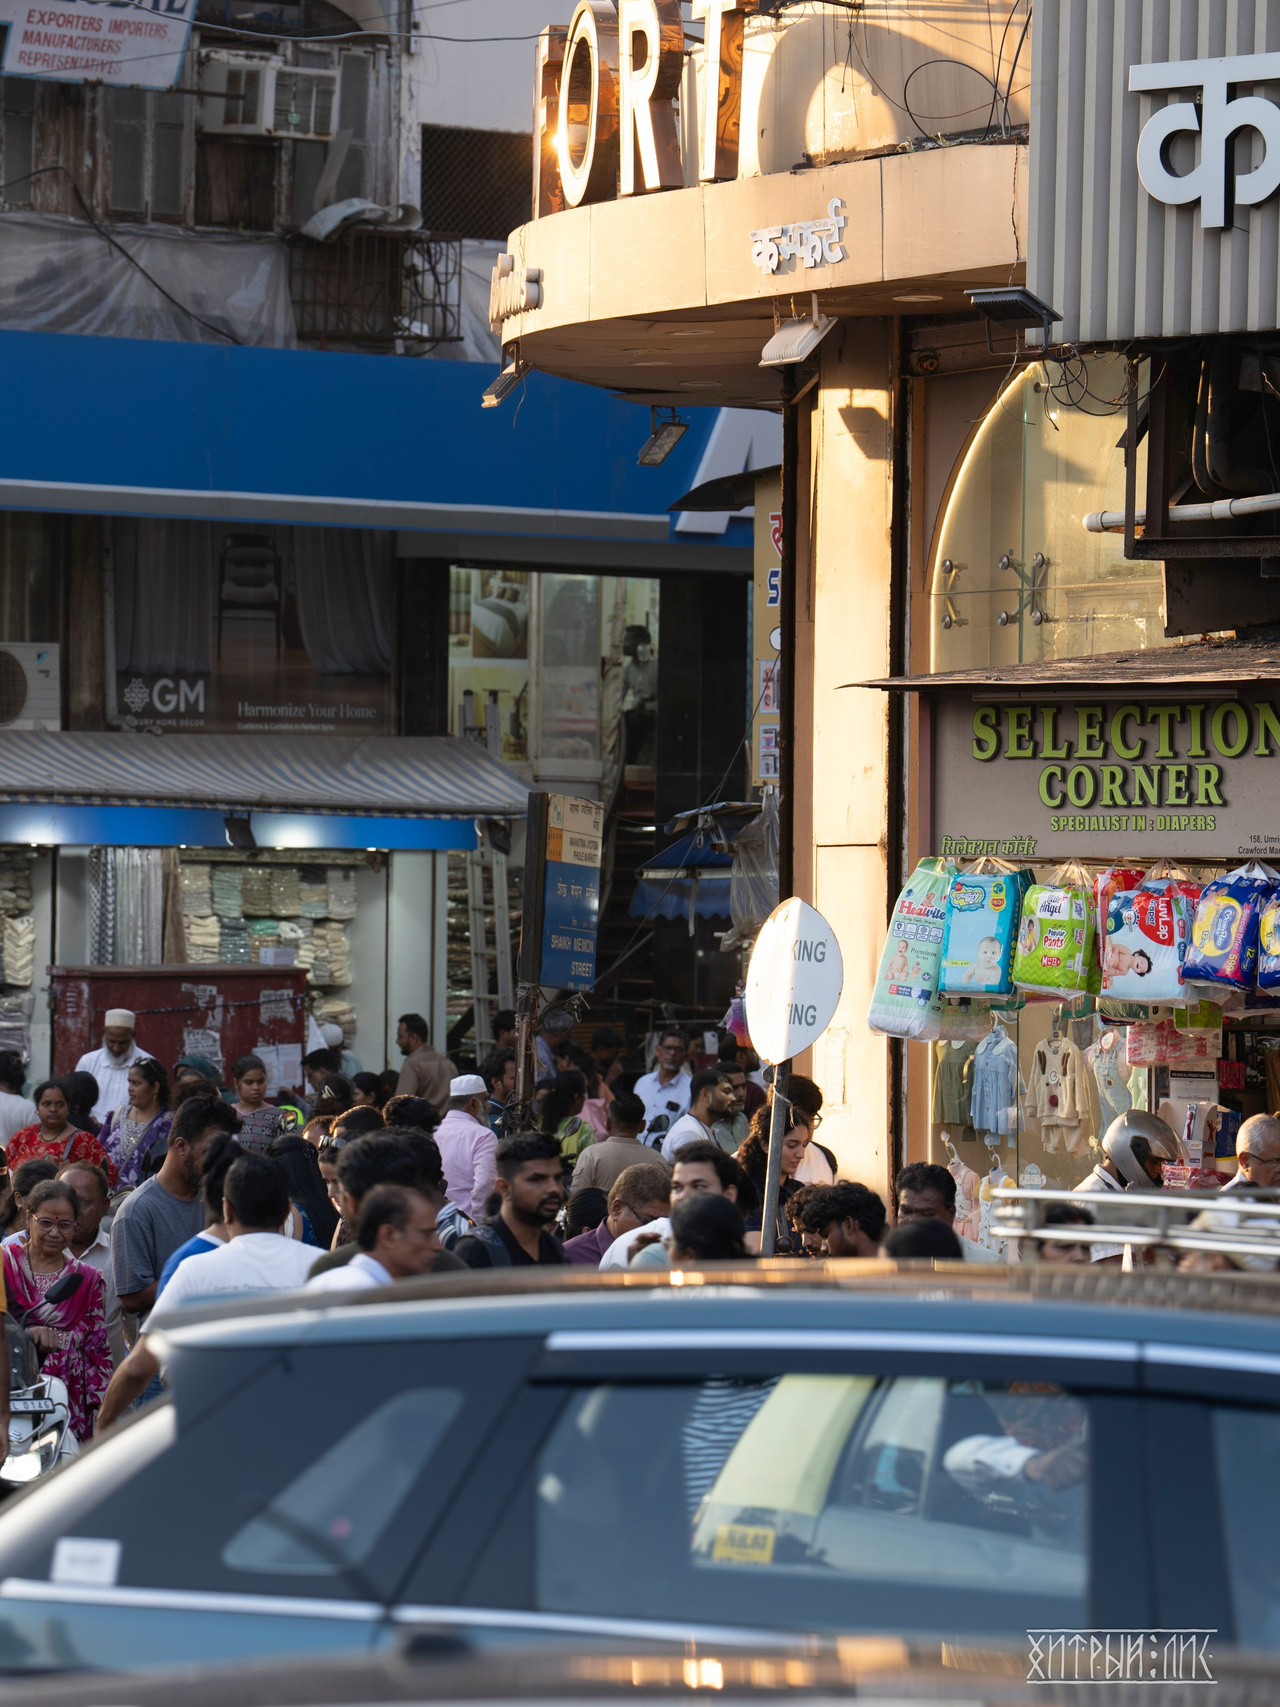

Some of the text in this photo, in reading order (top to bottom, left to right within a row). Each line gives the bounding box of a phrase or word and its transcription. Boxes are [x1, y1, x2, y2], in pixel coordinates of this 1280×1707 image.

[26, 9, 169, 39] EXPORTERS IMPORTERS
[21, 30, 123, 54] MANUFACTURERS
[17, 50, 123, 76] REPRESENTATIVES
[152, 678, 205, 713] GM
[238, 701, 376, 719] Harmonize Your Home
[156, 718, 177, 727] HOME
[1038, 764, 1226, 809] CORNER
[1050, 815, 1129, 832] SPECIALIST
[1131, 815, 1147, 831] IN
[1156, 815, 1216, 832] DIAPERS
[941, 834, 1038, 855] सिलेक्शन कॉर्नर
[1249, 835, 1280, 845] 158, Umri
[1238, 846, 1268, 855] Crawford
[898, 899, 946, 920] Healvite
[1040, 900, 1062, 917] Angel
[1157, 897, 1170, 940] LuvLap
[1048, 928, 1065, 937] Popular
[1234, 909, 1250, 950] Special Offer
[550, 934, 594, 954] SHAIKH MEMON
[791, 939, 827, 963] KING
[1043, 936, 1065, 948] Pants
[571, 961, 593, 977] STREET
[1226, 953, 1238, 971] 599
[788, 1003, 817, 1027] ING
[23, 1401, 50, 1410] 0146
